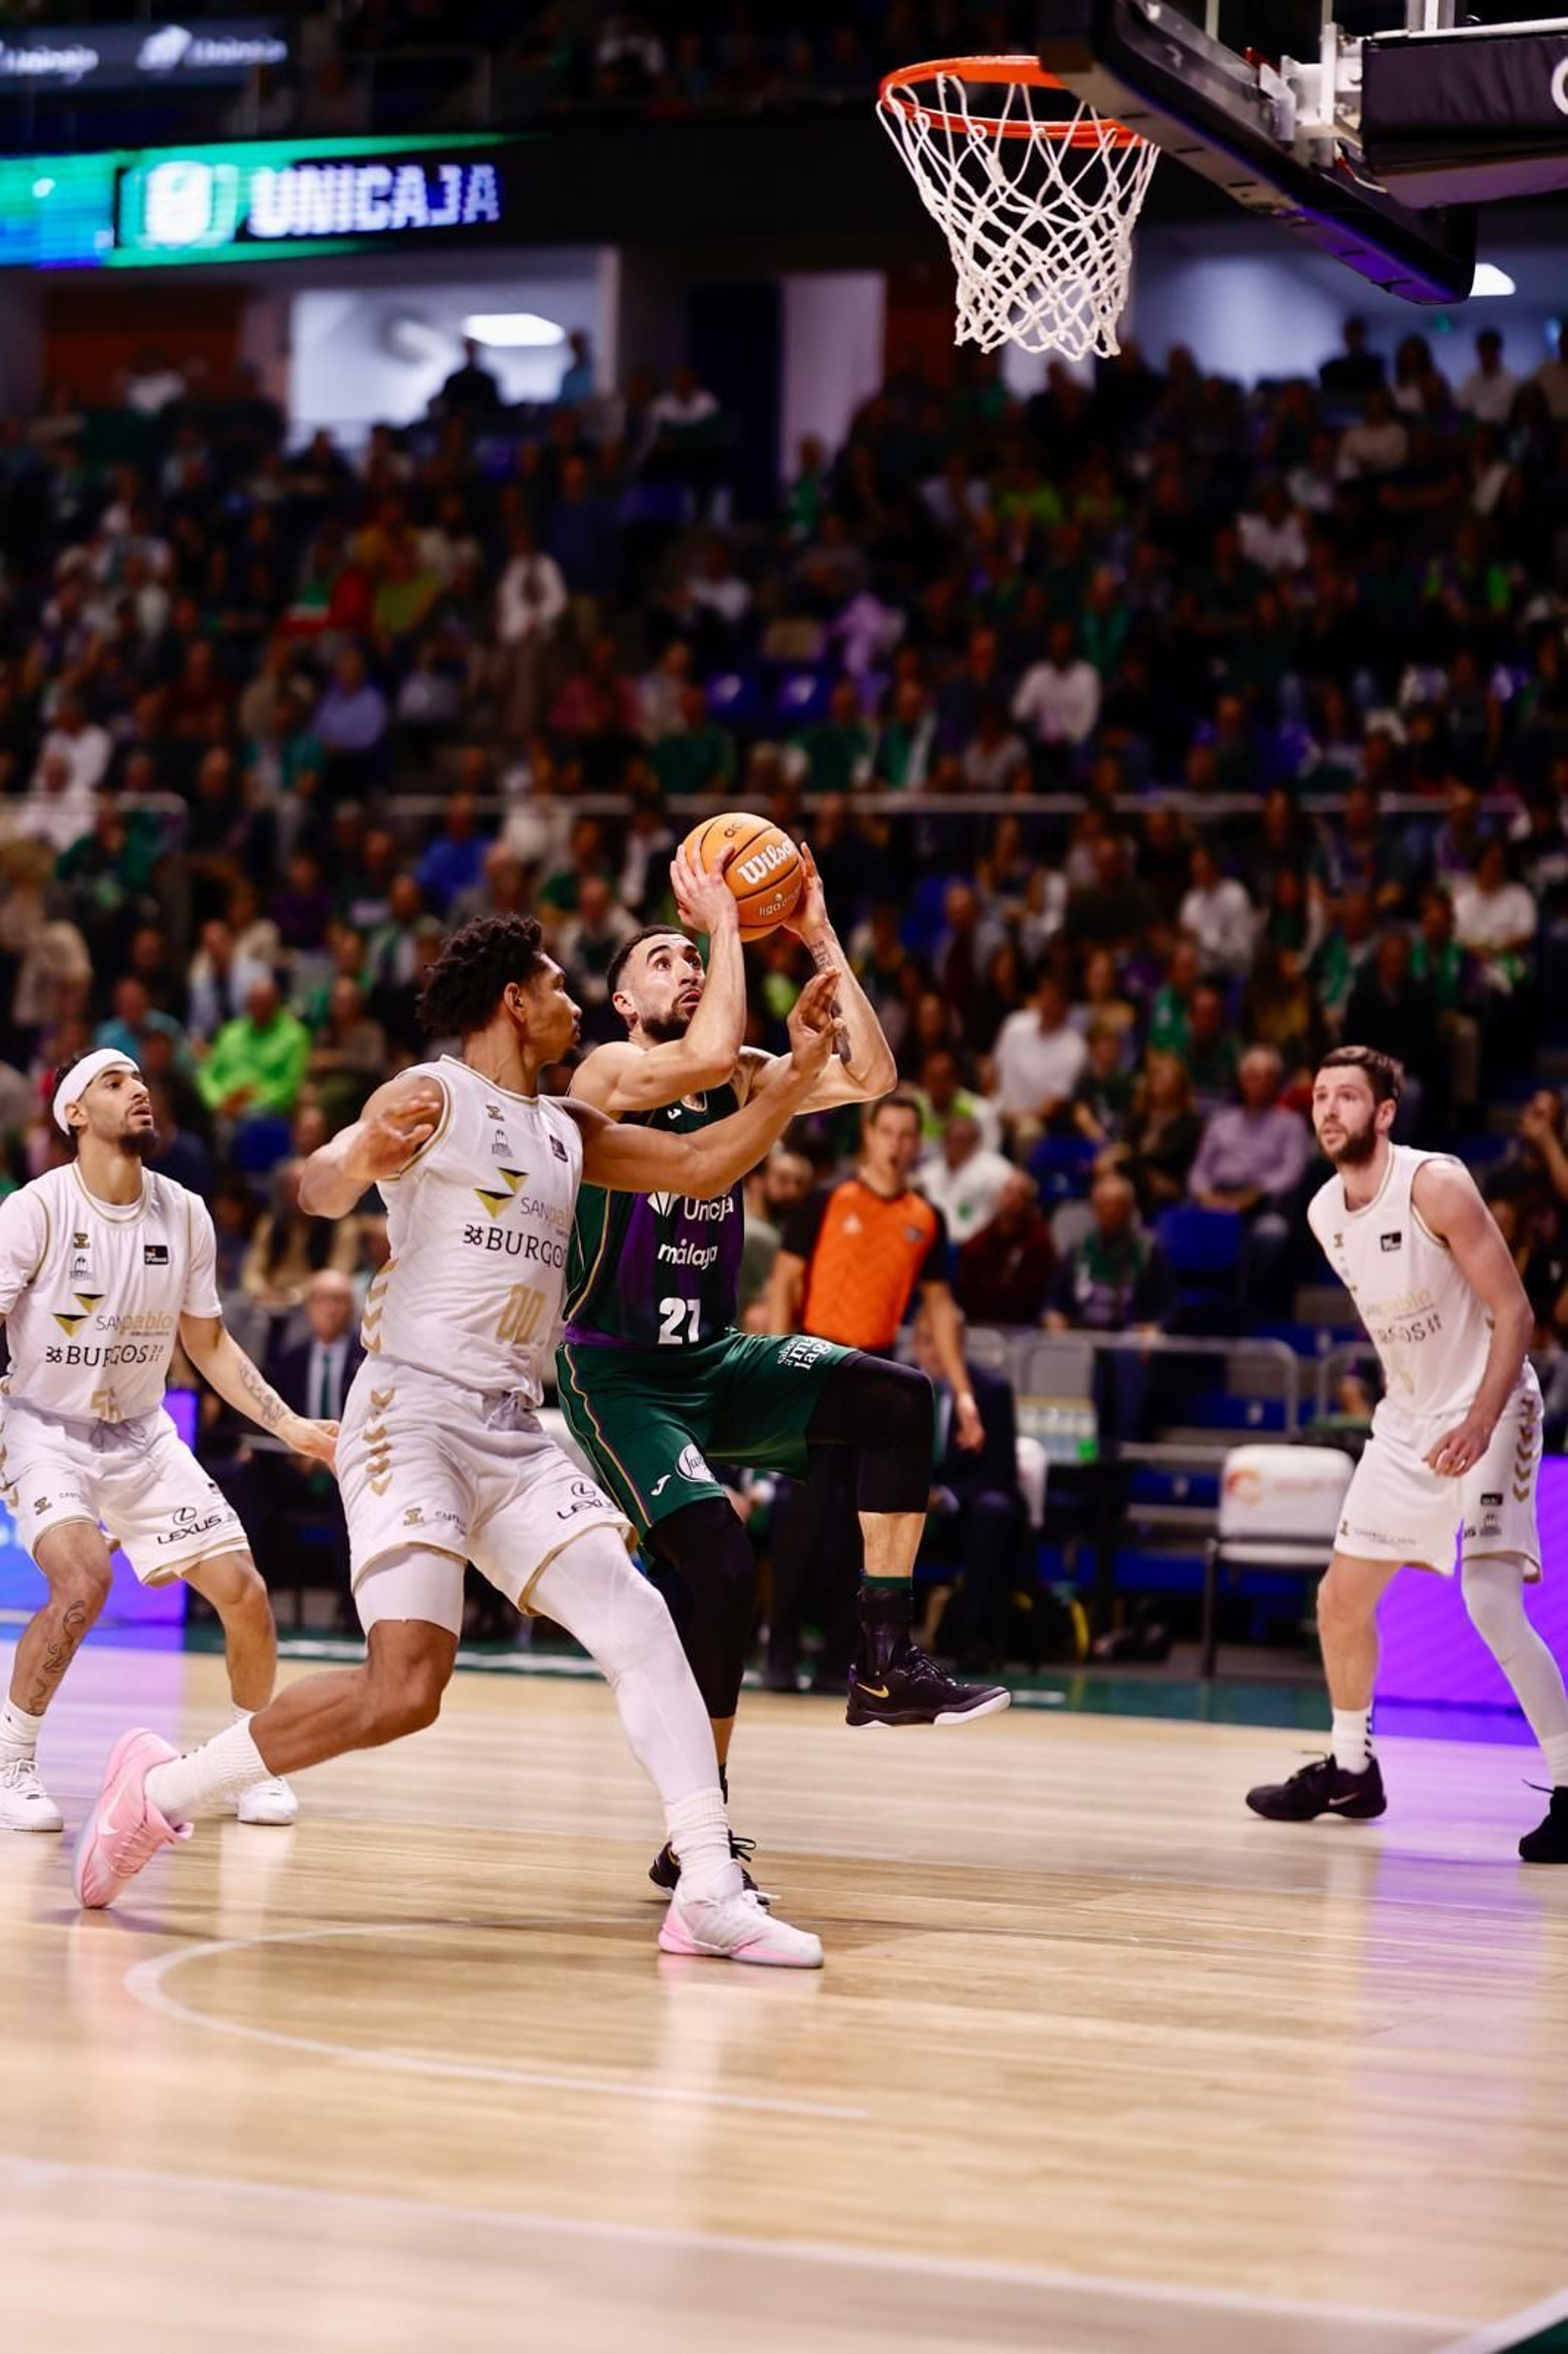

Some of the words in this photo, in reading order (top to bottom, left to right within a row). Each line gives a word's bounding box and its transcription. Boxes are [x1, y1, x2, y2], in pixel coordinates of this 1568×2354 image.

[247, 163, 500, 238] UNICAJA
[485, 1227, 567, 1269] BURGO
[66, 1344, 149, 1368] BURGOS
[157, 1514, 221, 1545] LEXUS
